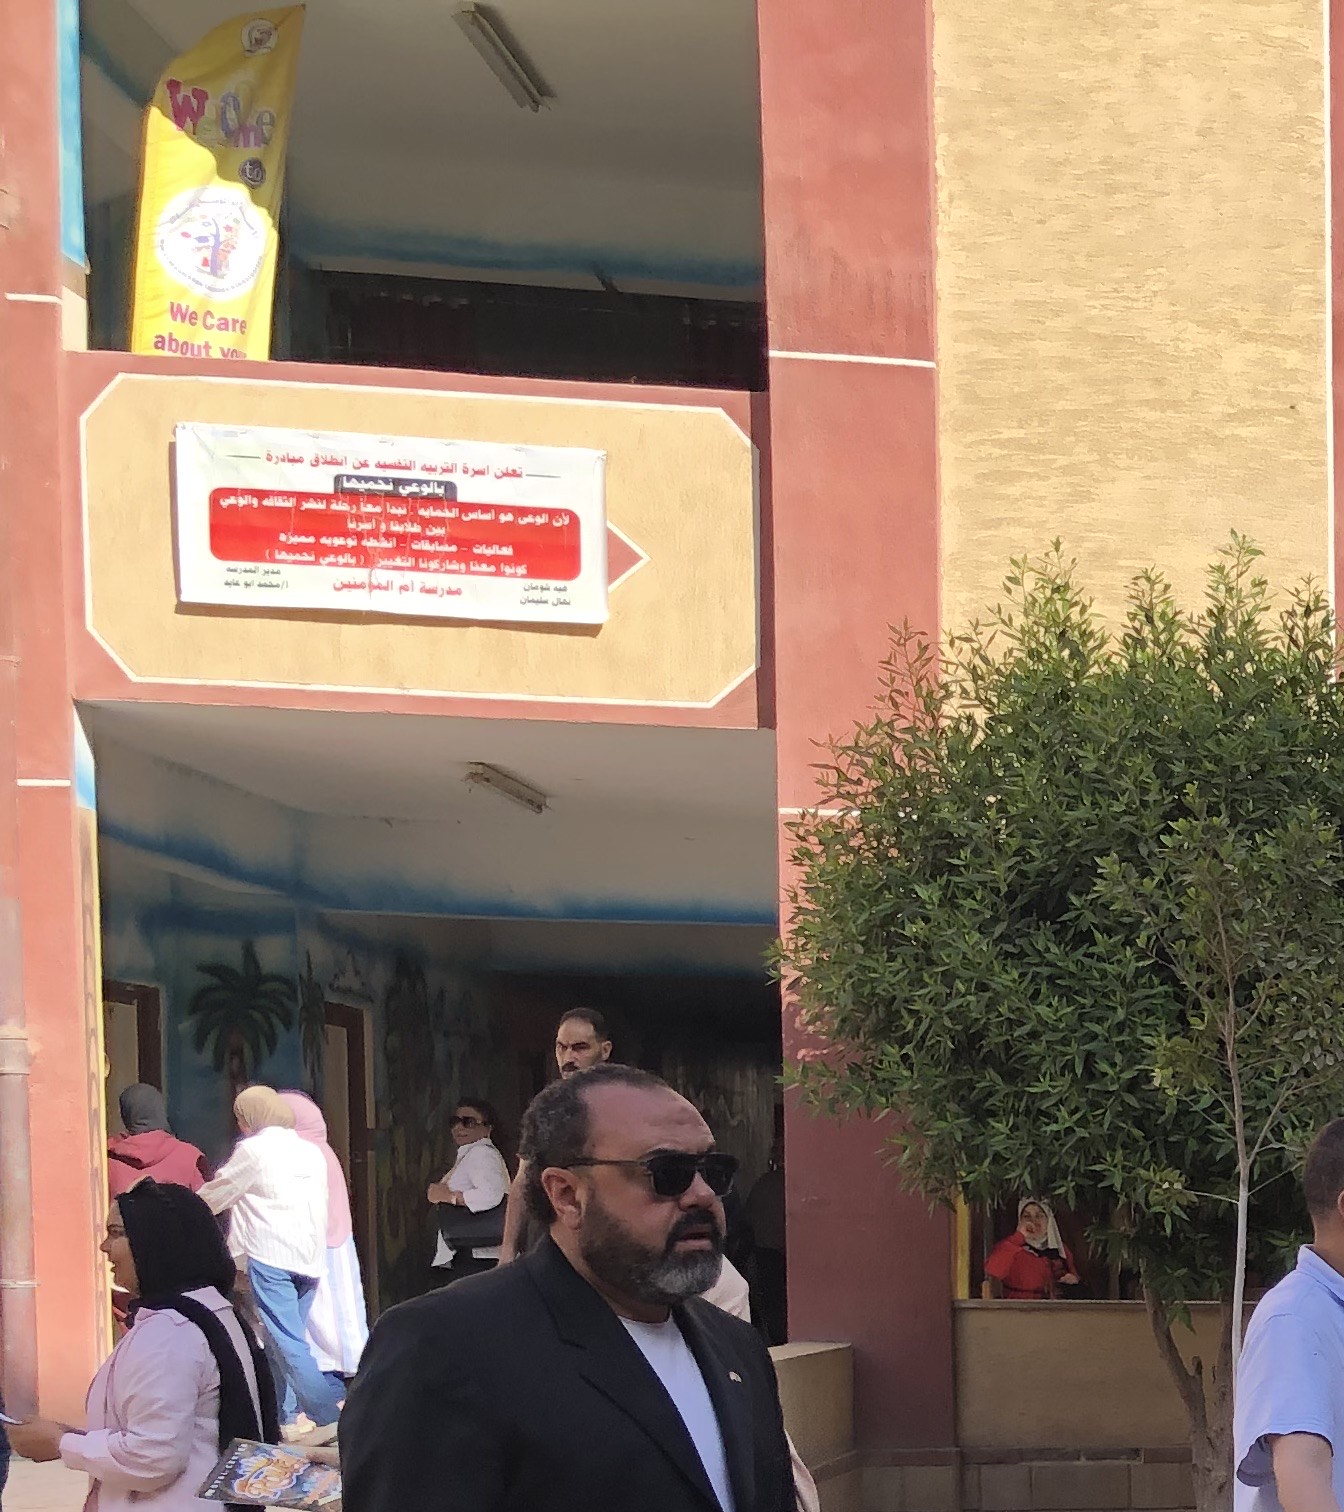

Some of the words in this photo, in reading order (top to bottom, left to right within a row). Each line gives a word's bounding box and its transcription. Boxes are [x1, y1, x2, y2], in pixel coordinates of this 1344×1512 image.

[169, 301, 198, 327] We
[202, 309, 247, 335] Care
[153, 331, 212, 358] about
[265, 449, 305, 466] مبادرة
[352, 457, 370, 470] عن
[494, 467, 523, 480] تعلن
[341, 475, 394, 492] نحميها
[398, 480, 445, 497] بالوعي
[498, 511, 515, 524] هو
[425, 524, 446, 537] بين
[274, 548, 316, 562] نحميها
[411, 540, 458, 555] مسابقات
[472, 544, 514, 558] فعاليات
[418, 557, 466, 574] وشاركونا
[469, 560, 496, 573] معنا
[500, 562, 528, 577] كونوا
[398, 579, 414, 595] أم
[419, 581, 462, 597] مدرسة
